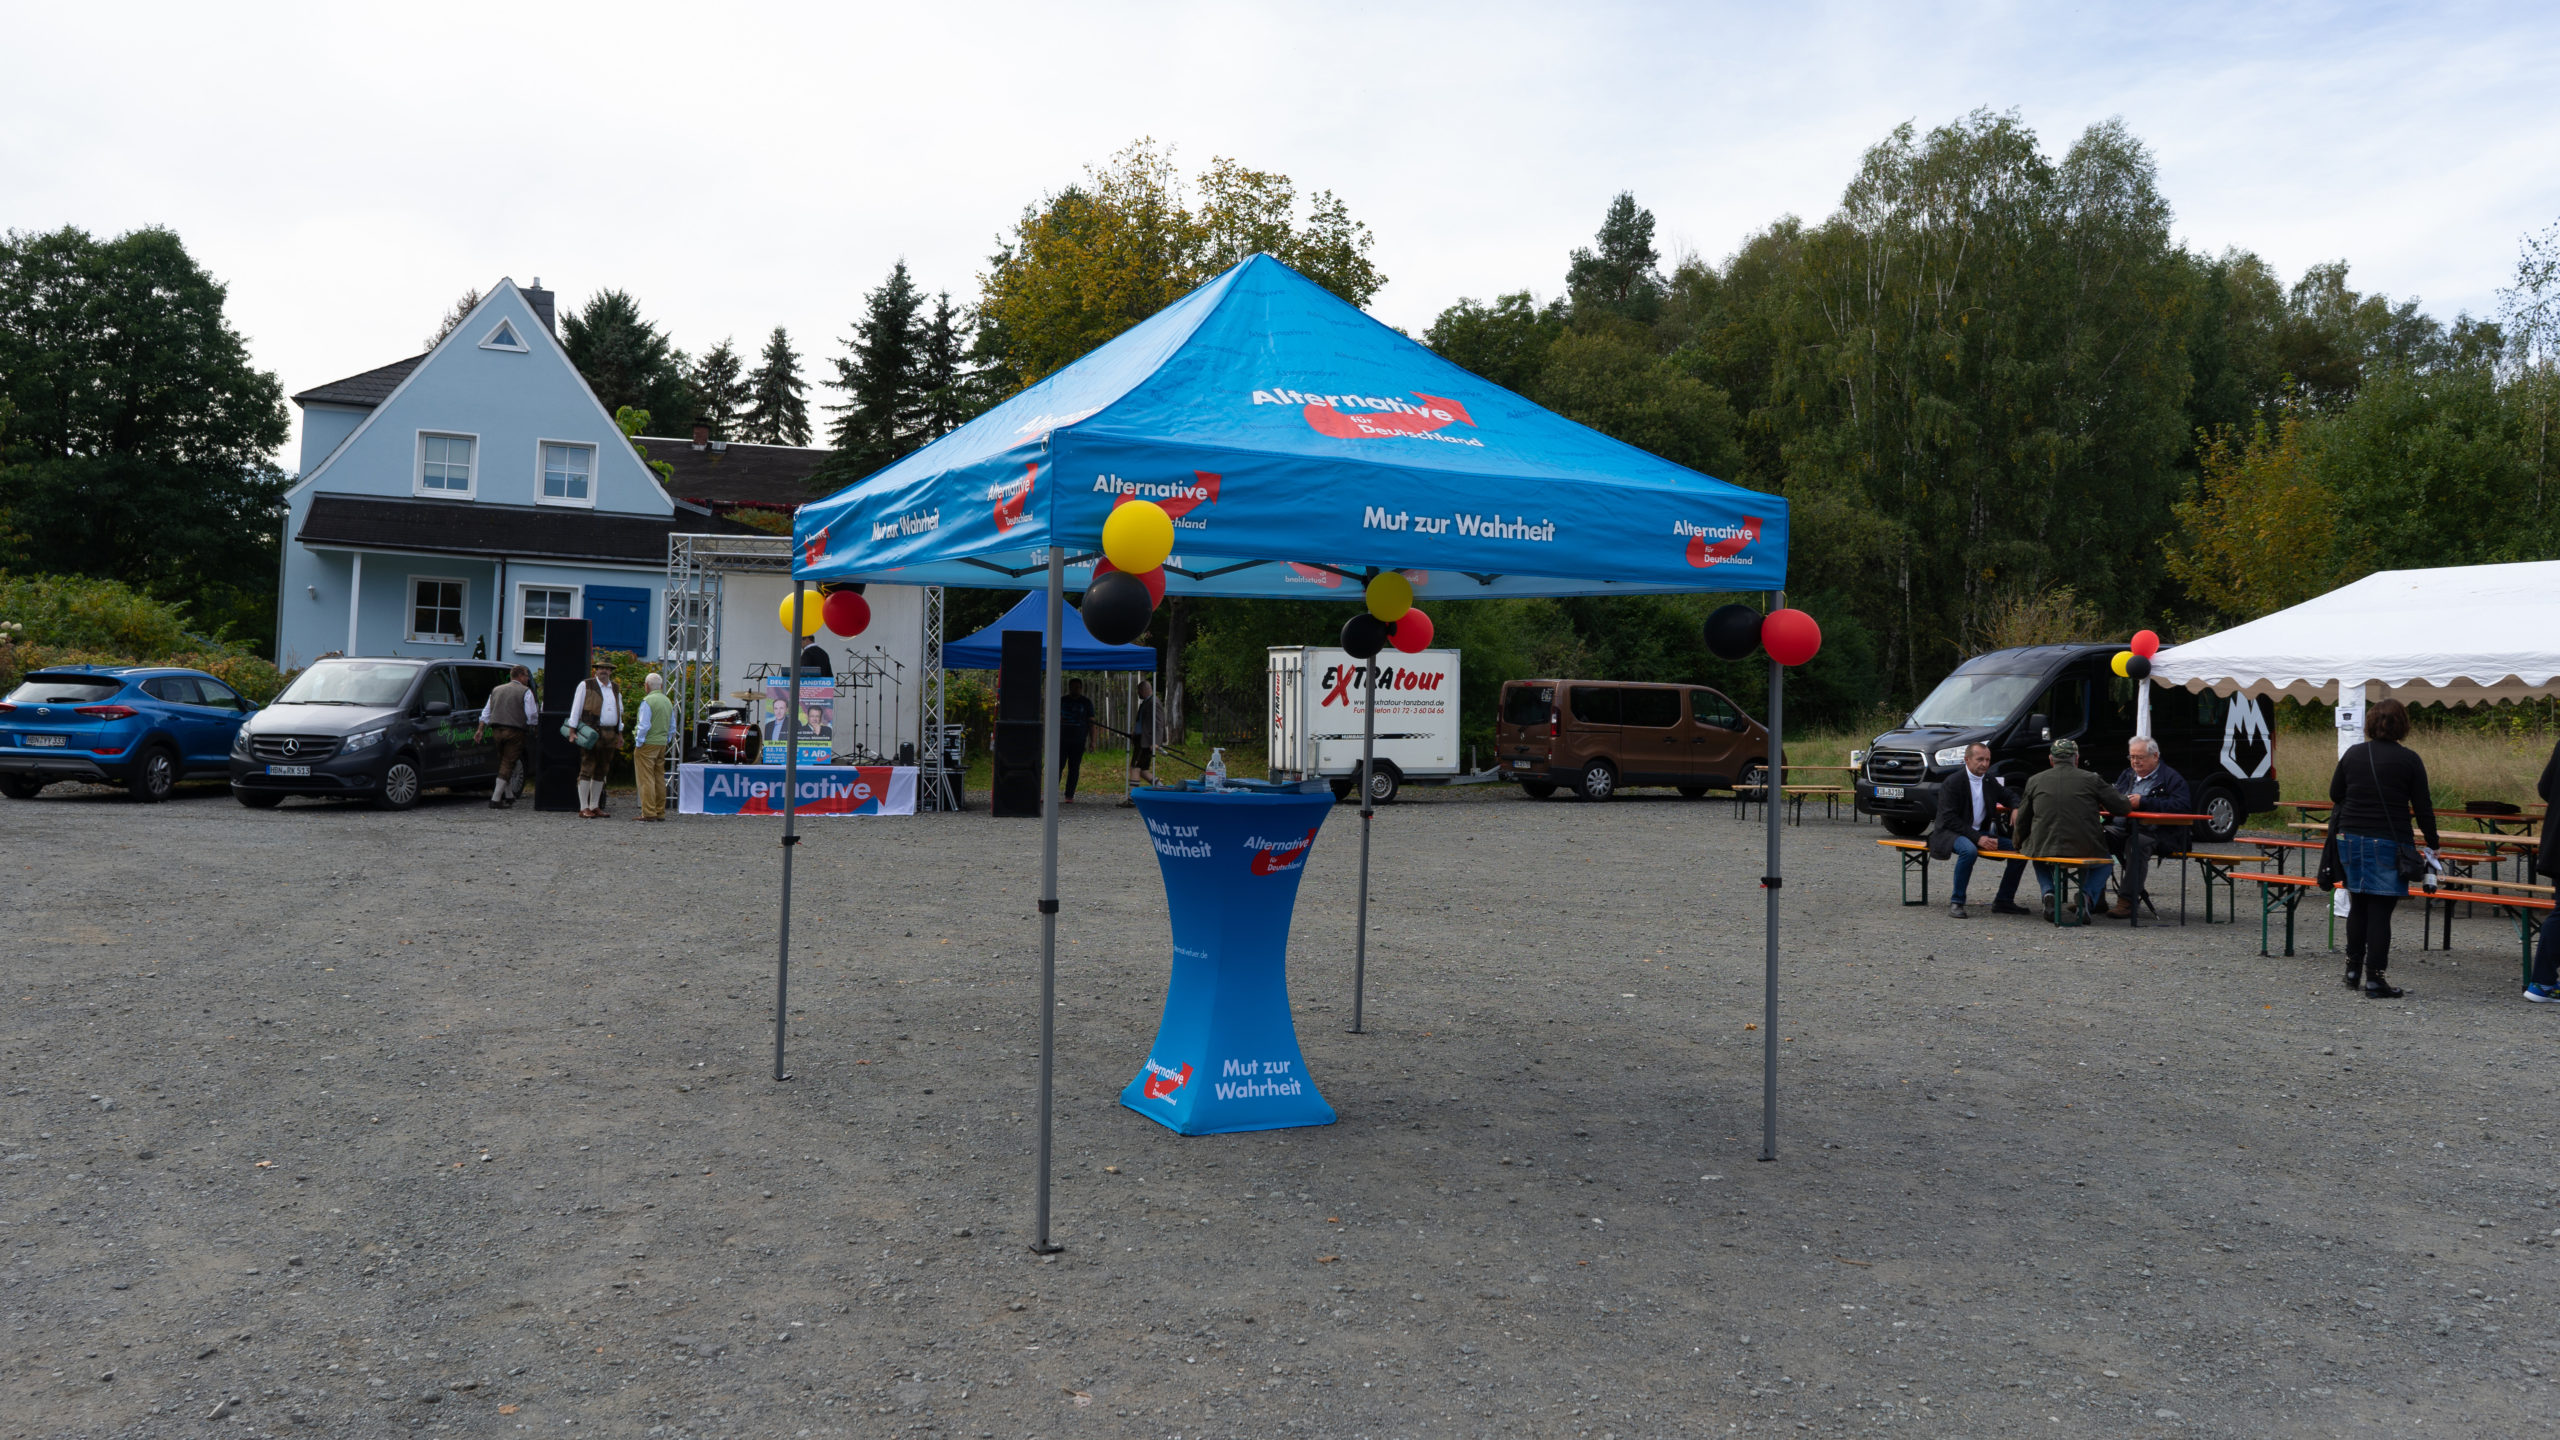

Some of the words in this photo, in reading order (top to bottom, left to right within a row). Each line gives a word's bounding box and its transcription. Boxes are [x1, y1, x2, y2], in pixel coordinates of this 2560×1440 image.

[1252, 388, 1454, 422] Alternative
[1350, 415, 1373, 424] für
[1359, 424, 1485, 447] Deutschland
[987, 475, 1031, 501] Alternative
[1093, 474, 1208, 500] Alternative
[899, 507, 940, 536] Wahrheit
[1171, 517, 1207, 529] chland
[1363, 506, 1409, 531] Mut
[1414, 516, 1450, 534] zur
[1455, 513, 1555, 542] Wahrheit
[1673, 519, 1753, 540] Alternative
[1704, 554, 1753, 565] Deutschland
[1321, 664, 1444, 707] EXTRAtour
[1353, 699, 1445, 707] wwextratour-tanzband.de
[811, 749, 827, 757] AfD
[1148, 817, 1171, 836] Mut
[1173, 825, 1199, 837] zur
[1152, 835, 1212, 858] Wahrheit
[1243, 836, 1310, 850] Alternative
[1145, 1058, 1184, 1085] Alternative
[1223, 1059, 1259, 1077] Mut
[1263, 1061, 1291, 1074] zur
[1215, 1077, 1301, 1100] Wahrheit
